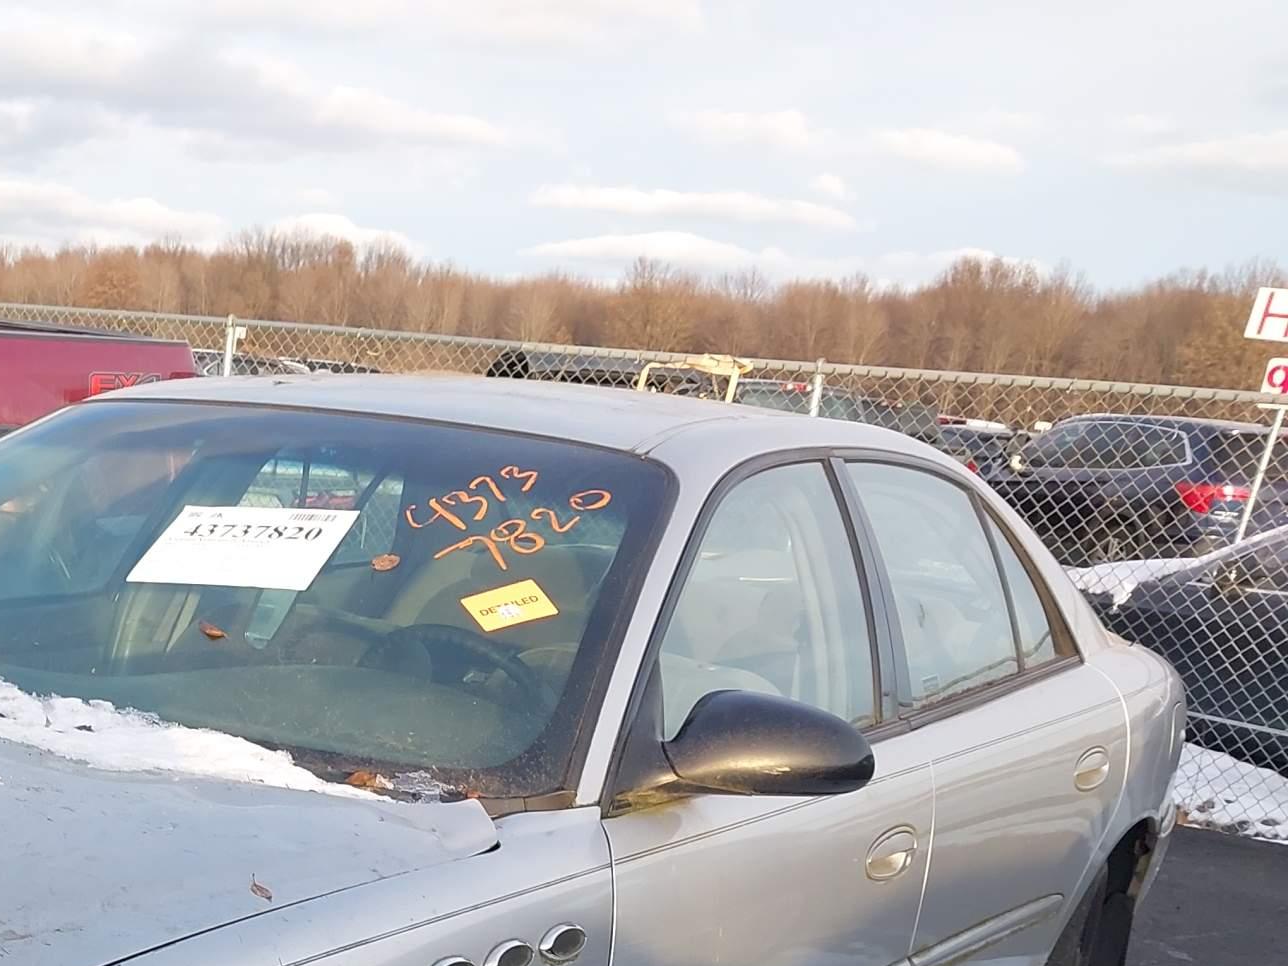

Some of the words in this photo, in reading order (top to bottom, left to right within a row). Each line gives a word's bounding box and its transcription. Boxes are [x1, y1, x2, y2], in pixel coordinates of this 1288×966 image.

[406, 464, 539, 531] 4373
[432, 488, 613, 571] 7820
[183, 523, 324, 542] 43737820
